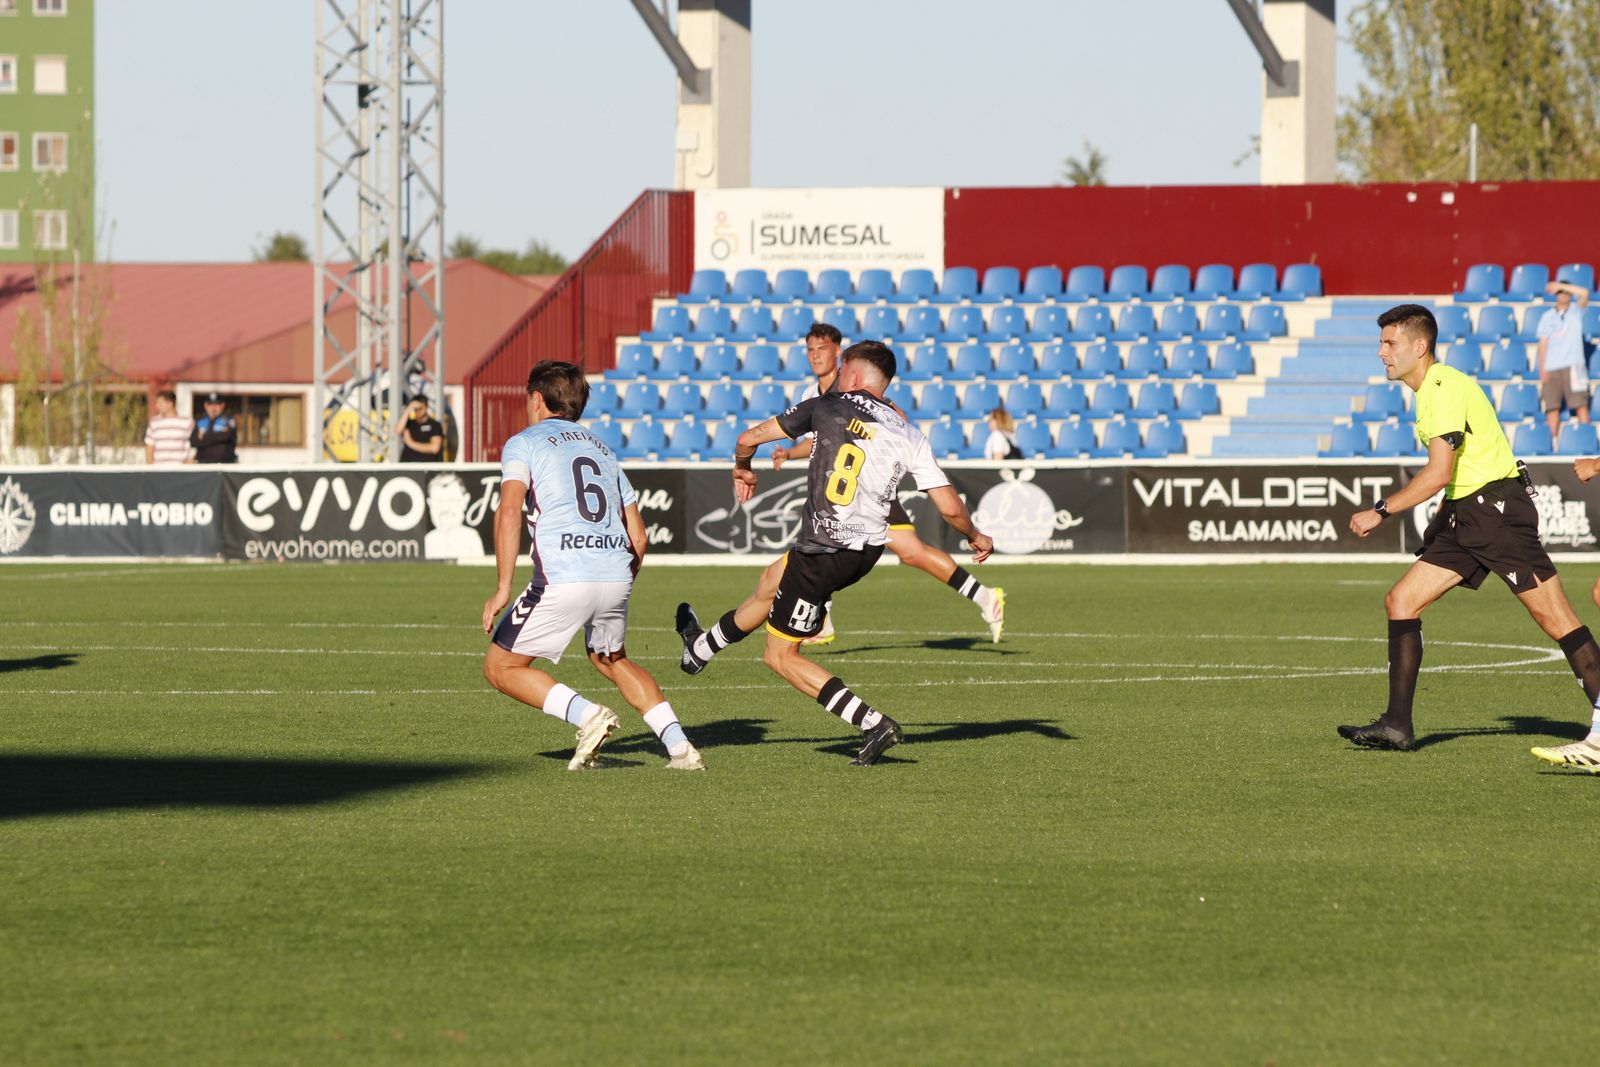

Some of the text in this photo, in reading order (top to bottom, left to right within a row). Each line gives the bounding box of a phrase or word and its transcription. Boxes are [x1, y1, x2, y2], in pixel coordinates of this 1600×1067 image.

[760, 225, 892, 246] SUMESAL
[571, 455, 608, 523] 6
[825, 443, 866, 507] 8
[237, 476, 426, 532] evvo
[1132, 476, 1394, 508] VITALDENT
[50, 502, 214, 527] CLIMA-TOBIO
[1188, 519, 1339, 542] SALAMANCA
